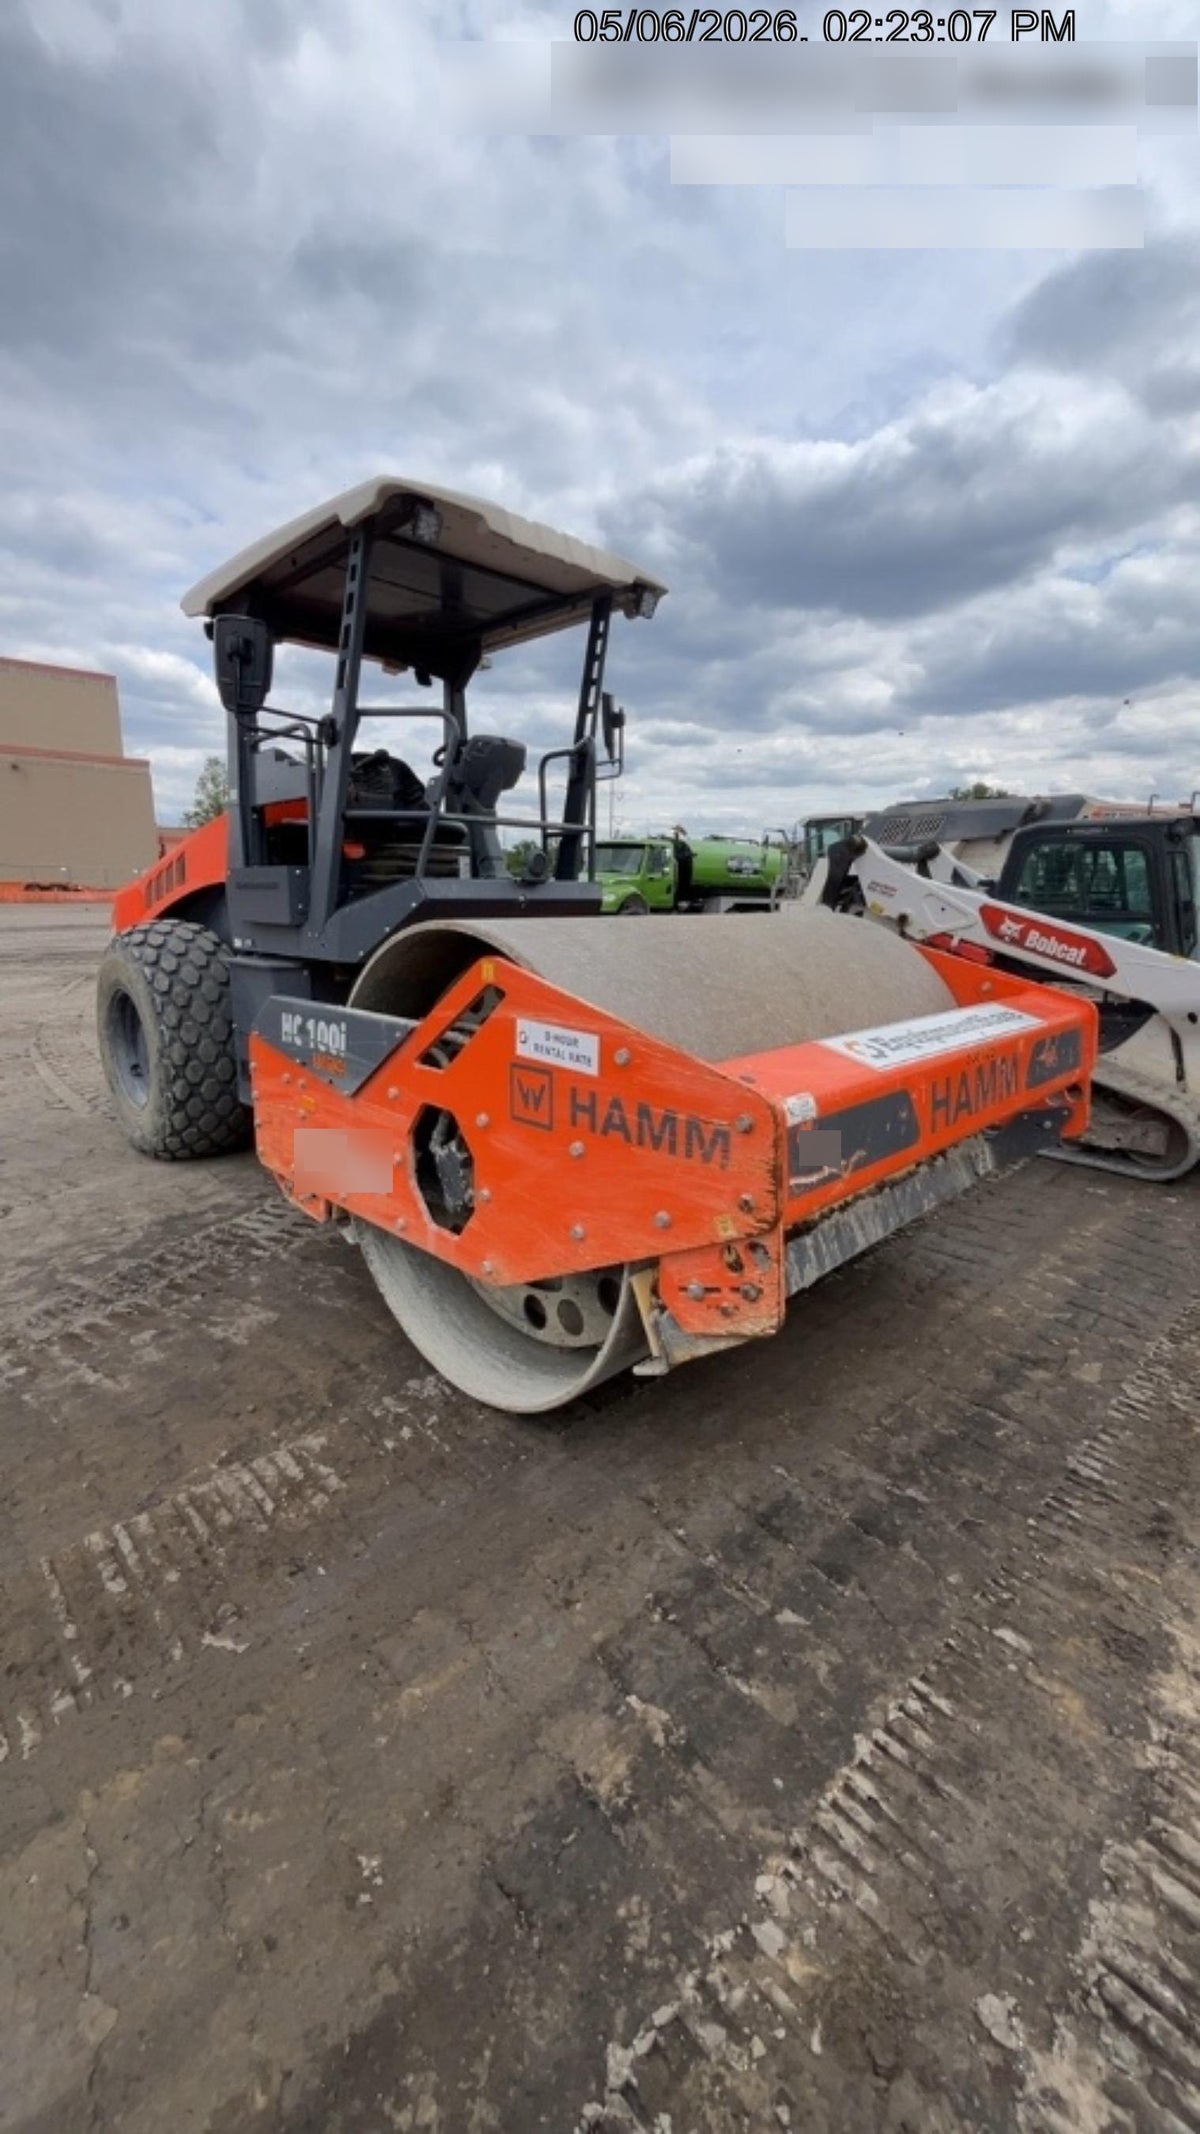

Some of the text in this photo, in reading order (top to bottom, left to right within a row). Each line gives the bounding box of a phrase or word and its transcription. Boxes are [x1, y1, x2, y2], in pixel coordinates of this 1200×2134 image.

[1024, 929, 1087, 966] Bobcat
[281, 1012, 347, 1058] HC 100i
[930, 1054, 1019, 1134] HAMM
[570, 1086, 732, 1170] HAMM
